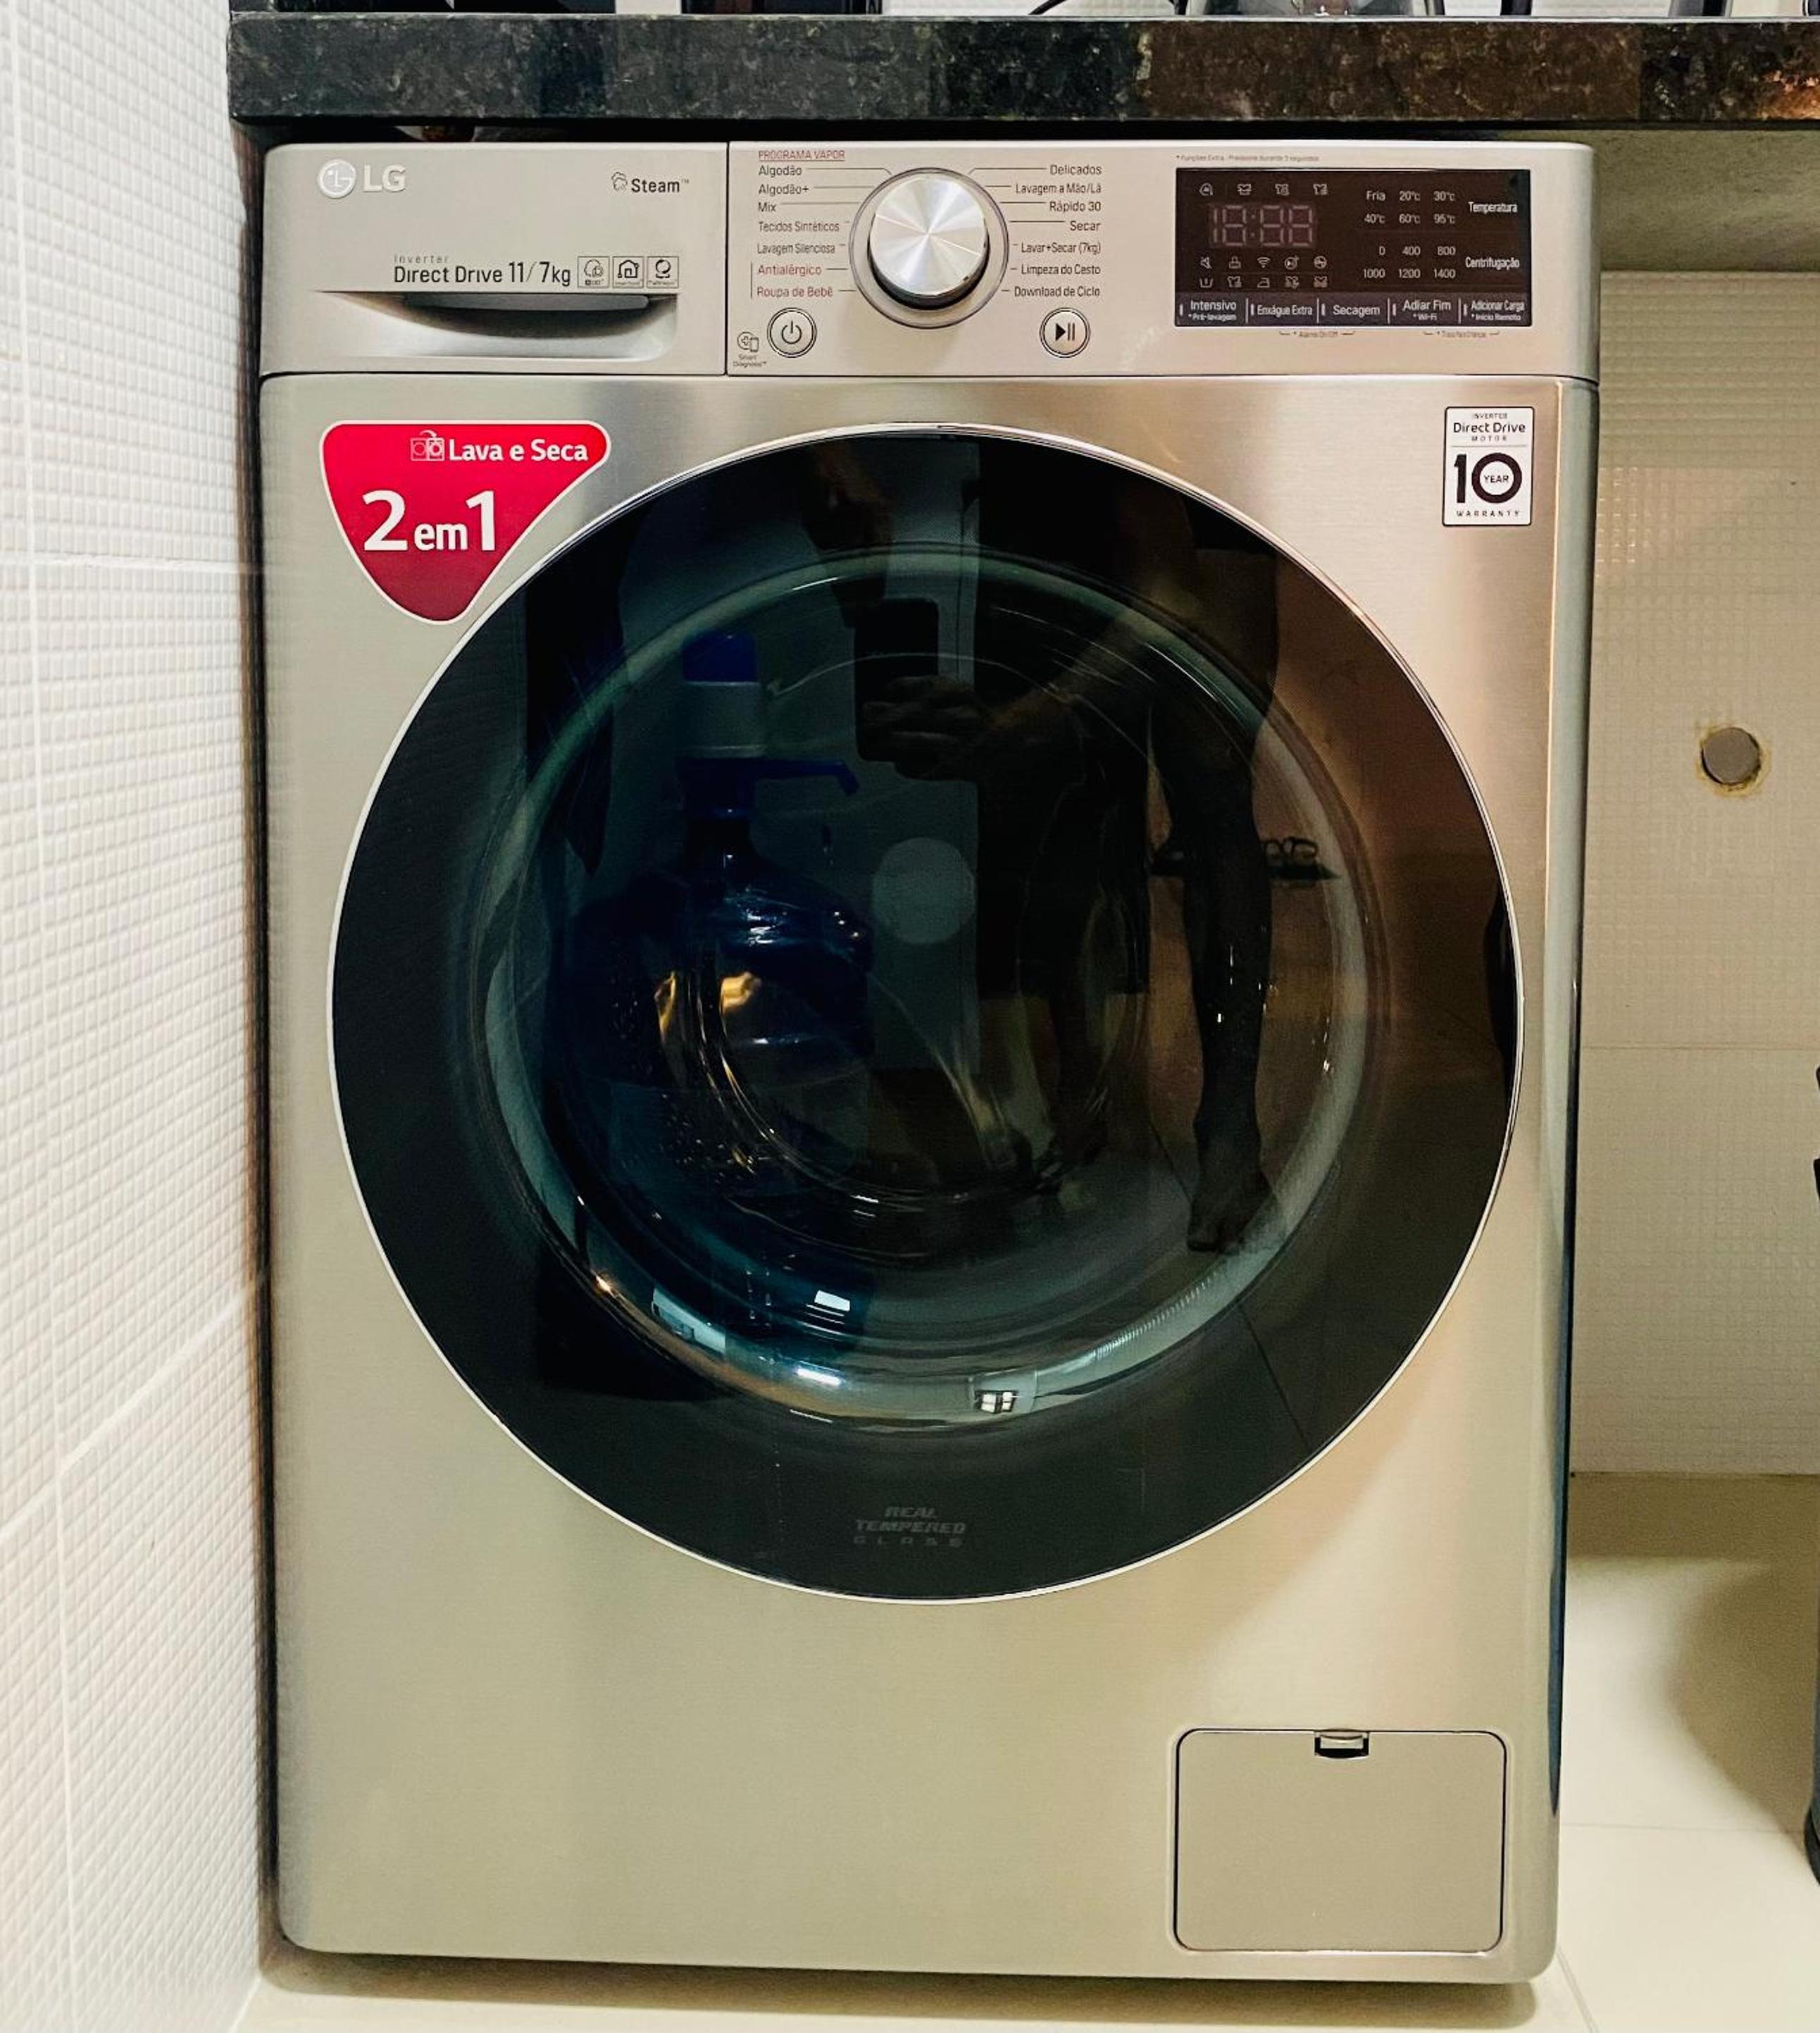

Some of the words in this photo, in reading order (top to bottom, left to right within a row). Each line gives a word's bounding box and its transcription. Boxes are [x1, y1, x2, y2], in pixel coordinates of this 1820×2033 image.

[759, 150, 811, 159] PROGRAMA
[814, 150, 845, 159] VAPOR
[759, 165, 802, 178] Algodão
[1049, 164, 1102, 175] Delicados
[363, 164, 407, 192] LG
[759, 184, 809, 197] Algodão+
[1016, 183, 1057, 195] Lavagem
[1059, 185, 1064, 194] a
[1366, 191, 1386, 201] Fria
[758, 202, 777, 212] Mix
[1049, 201, 1085, 213] Rápido
[1087, 201, 1102, 211] 30
[1468, 201, 1519, 214] Temperatura
[759, 221, 792, 232] Tecidos
[794, 221, 840, 232] Sintéticos
[1070, 220, 1102, 231] Secar
[757, 243, 793, 255] Lavagem
[794, 243, 835, 254] Silenciosa
[1021, 242, 1077, 253] Lavar+Secar
[1078, 242, 1102, 255] (7kg)
[1402, 247, 1421, 256] 400
[1437, 247, 1456, 256] 800
[394, 254, 449, 264] Inverter
[1465, 256, 1520, 270] Centrifugação
[394, 266, 449, 282] Direct
[454, 266, 503, 282] Drive
[758, 264, 822, 277] Antialérgico
[1021, 264, 1059, 275] Limpeza
[1061, 264, 1072, 275] do
[1074, 264, 1101, 275] Cesto
[1364, 269, 1386, 279] 1000
[1398, 269, 1421, 279] 1200
[1433, 269, 1456, 279] 1400
[757, 287, 790, 298] Roupa
[792, 286, 804, 297] de
[807, 286, 833, 297] Bebê
[1014, 286, 1061, 297] Download
[1064, 286, 1075, 297] de
[1077, 286, 1100, 297] Ciclo
[1190, 299, 1237, 311] Intensivo
[1257, 304, 1291, 317] Enxágue
[1292, 304, 1313, 315] Extra
[1333, 304, 1380, 317] Secagem
[1402, 299, 1431, 311] Adiar
[1433, 299, 1452, 311] Fim
[1471, 299, 1503, 311] Adicionar
[1504, 299, 1525, 312] Carga
[1453, 423, 1490, 433] Direct
[1492, 423, 1526, 433] Drive
[449, 438, 504, 461] Lava
[509, 444, 525, 461] e
[531, 438, 589, 461] Seca
[1454, 452, 1523, 504] 10
[1483, 475, 1509, 483] YEAR
[362, 490, 409, 551] 2
[414, 522, 468, 551] em
[465, 490, 496, 551] 1
[885, 1506, 937, 1518] REAL
[856, 1519, 966, 1534] TEMPERED
[854, 1535, 963, 1548] GLASS
